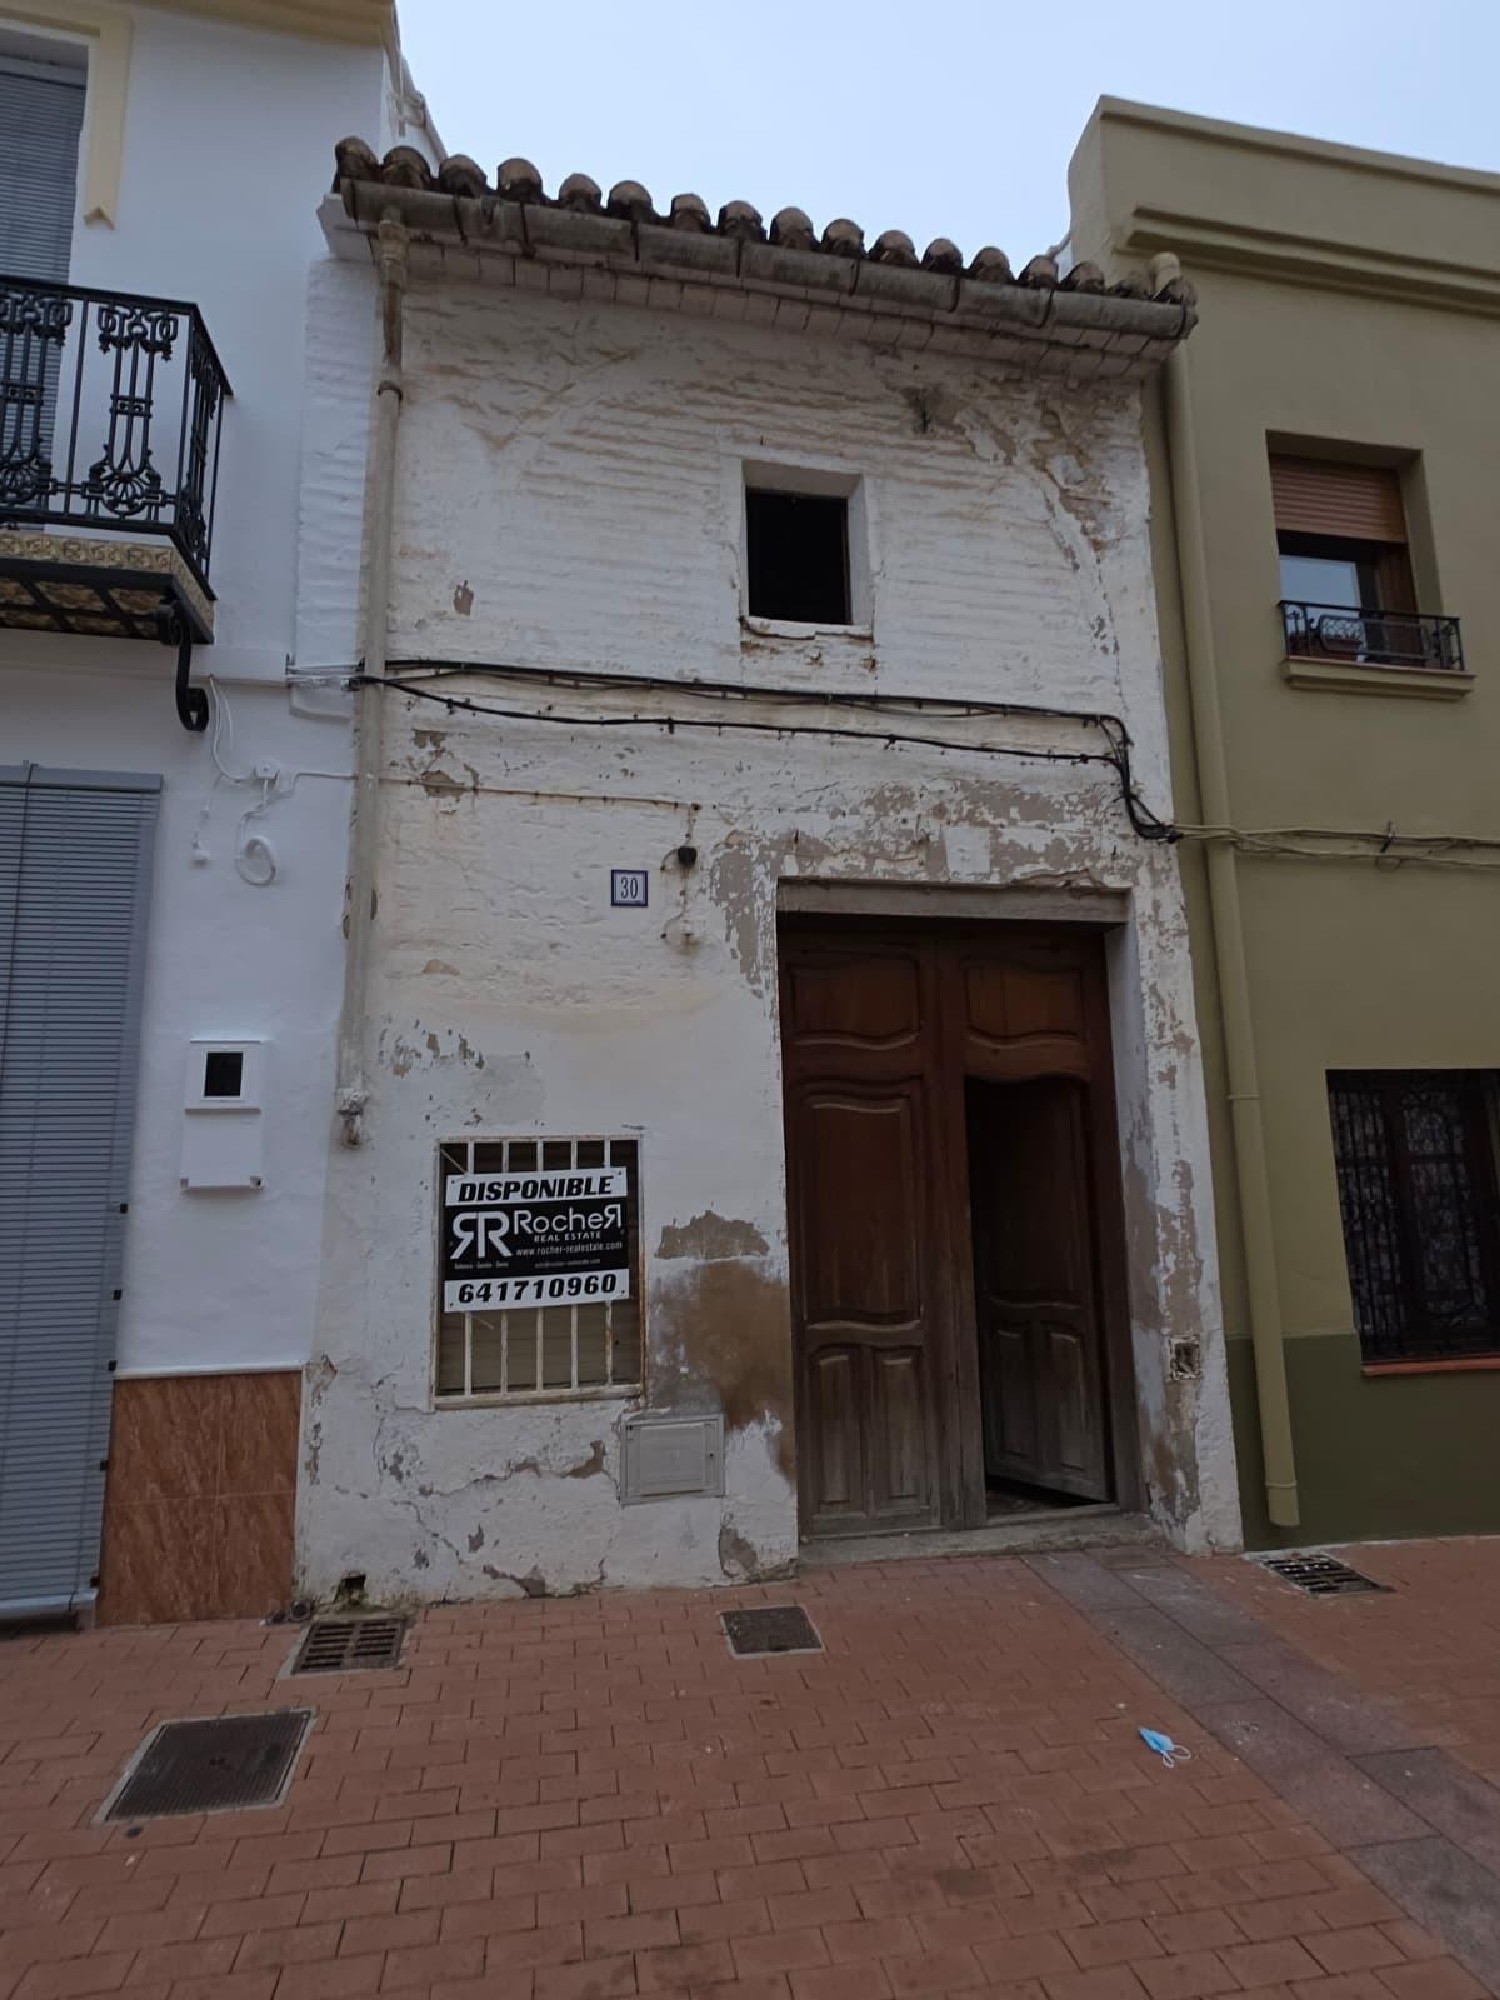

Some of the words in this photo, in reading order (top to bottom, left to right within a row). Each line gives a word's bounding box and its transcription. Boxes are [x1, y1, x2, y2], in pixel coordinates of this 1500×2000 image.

[620, 876, 639, 899] 30
[458, 1176, 615, 1202] DISPONIBLE
[534, 1234, 560, 1243] REAL
[564, 1231, 601, 1241] ESTATE
[459, 1274, 617, 1304] 641710960
